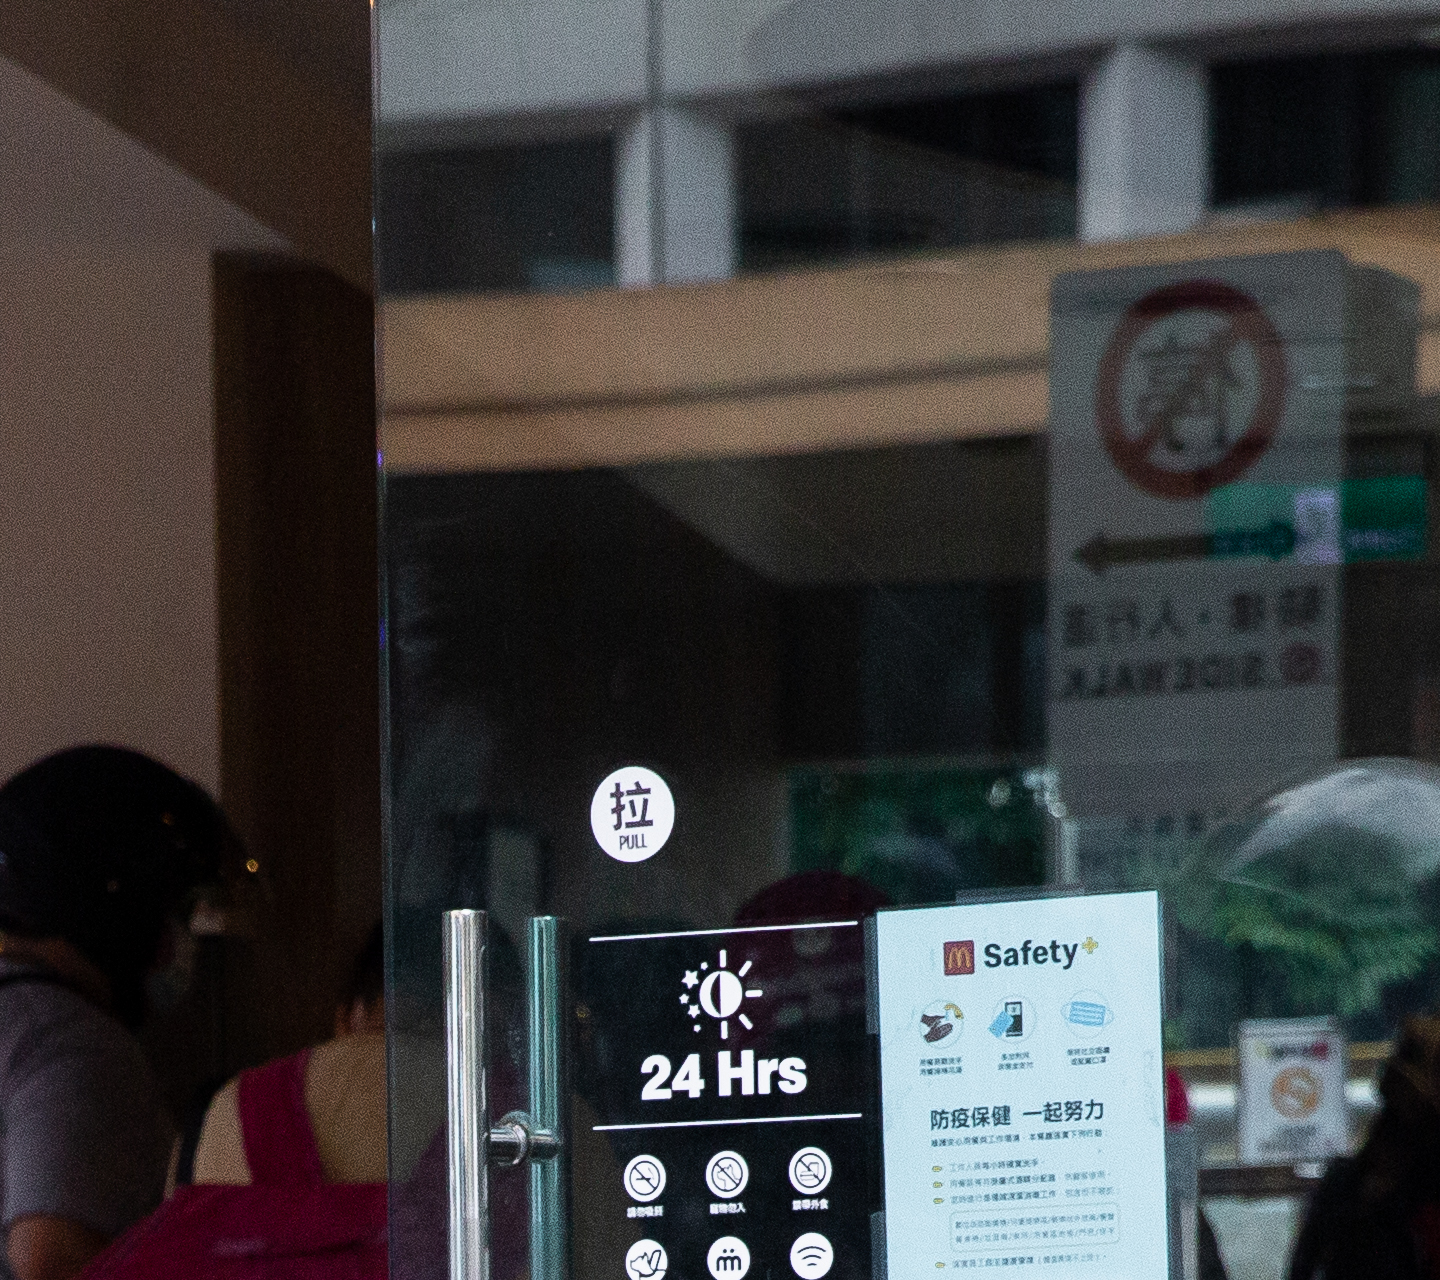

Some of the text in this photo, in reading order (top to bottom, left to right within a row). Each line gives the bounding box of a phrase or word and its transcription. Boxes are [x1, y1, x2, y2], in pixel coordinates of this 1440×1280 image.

[609, 781, 654, 831] 拉
[618, 834, 648, 851] PULL
[640, 1050, 808, 1101] 24 Hrs
[930, 1098, 1105, 1132] 防疫保健 一起努力
